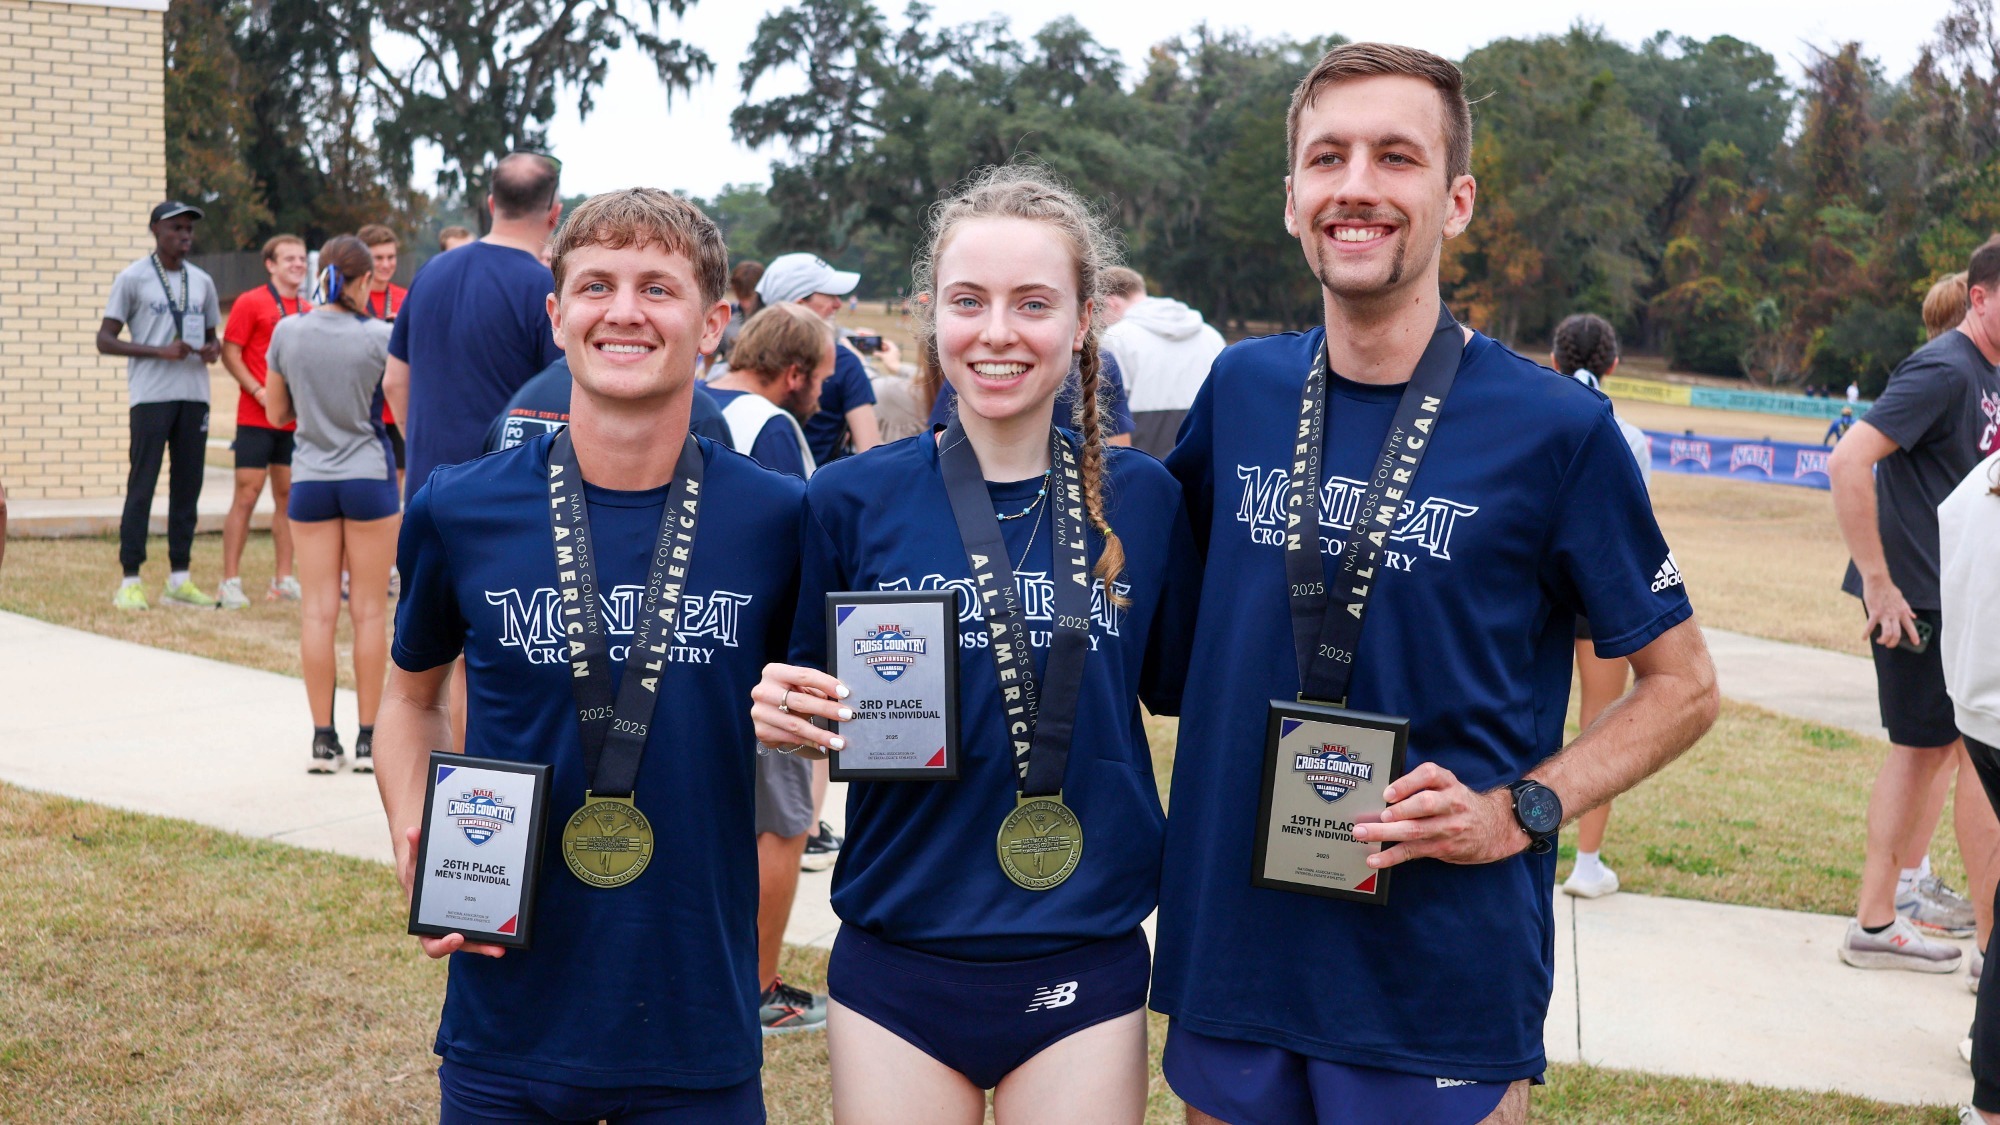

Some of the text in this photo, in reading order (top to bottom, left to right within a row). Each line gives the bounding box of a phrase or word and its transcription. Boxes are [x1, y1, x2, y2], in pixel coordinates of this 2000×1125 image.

[1311, 400, 1321, 440] CROSS
[1287, 353, 1322, 551] LL-AMERICAN
[1306, 446, 1317, 508] COUNTRY
[1056, 474, 1065, 512] CROSS
[1344, 427, 1405, 572] NAIA CROSS COUNTRY
[1062, 439, 1088, 587] ALL-AMERI
[1346, 395, 1441, 619] ALL-AMERICAN
[1058, 517, 1066, 546] NAIA
[1251, 527, 1285, 546] CRO
[550, 464, 590, 678] ALL-AMERICAN
[570, 493, 599, 635] NAIA CROSS COUNTRY
[636, 507, 677, 648] NAIA CROSS COUNTRY
[640, 478, 700, 694] ALL-AMERICAN
[1651, 571, 1683, 592] adida
[1292, 582, 1324, 596] 2025
[878, 624, 900, 633] NAIA
[1002, 587, 1018, 618] NAIA
[1012, 623, 1028, 666] CROSS
[1058, 615, 1089, 630] 2025
[854, 639, 925, 654] CROSS COUNTRY
[1318, 644, 1352, 664] 2025
[867, 656, 913, 664] CHAMPIONSHIPS
[580, 706, 614, 722] 2025
[852, 710, 940, 720] OMEN'S INDIVIDUAL
[860, 700, 922, 710] 3RD PLACE
[614, 718, 648, 736] 2025
[1323, 744, 1346, 755] NAIA
[1296, 756, 1371, 778] CROSS COUNTRY
[1307, 776, 1356, 786] CHAMPIONSHIPS
[473, 790, 493, 799] NAIA
[449, 801, 514, 821] CROSS COUNTRY
[573, 803, 646, 830] ALL-AMERICAN
[1007, 802, 1075, 832] ALL-AMERICAN
[1282, 825, 1312, 836] MEN'S
[1290, 815, 1354, 832] 19TH PLAC
[442, 858, 506, 876] 26TH PLACE
[583, 871, 610, 883] CROSS
[613, 852, 648, 882] COUNTRY
[1019, 877, 1044, 886] CROSS
[1047, 850, 1078, 884] COUNTRY
[435, 869, 511, 886] MEN'S INDIVIDUAL
